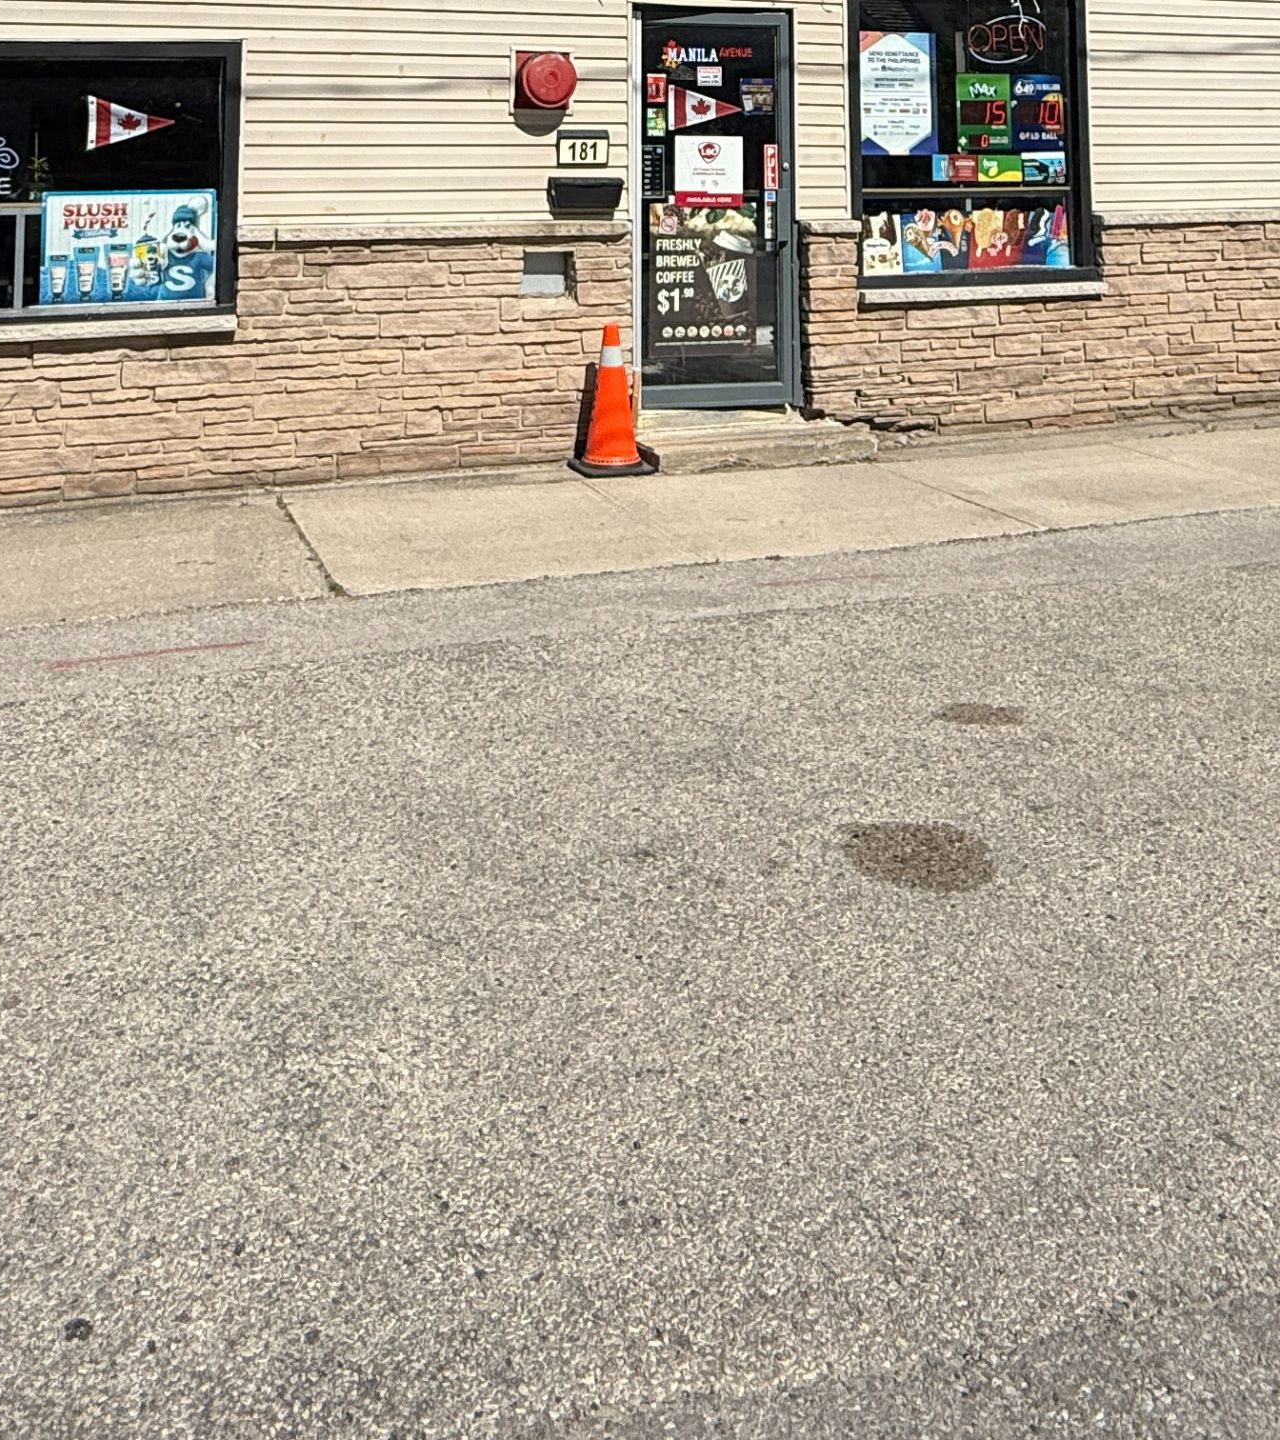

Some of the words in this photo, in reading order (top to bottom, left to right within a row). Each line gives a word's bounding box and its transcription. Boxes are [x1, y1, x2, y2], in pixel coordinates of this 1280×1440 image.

[968, 24, 1044, 52] OPEN
[668, 47, 719, 63] MANILA
[719, 46, 753, 58] AVENUE
[985, 100, 1006, 125] 15
[1039, 100, 1059, 125] 10
[981, 134, 989, 148] 0
[1041, 131, 1058, 140] BALL
[568, 141, 598, 162] 181
[766, 146, 776, 188] PULL
[62, 203, 129, 217] SLUSH
[656, 238, 702, 252] FRESHLY
[656, 254, 700, 268] BREWED
[656, 270, 695, 284] COFFEE
